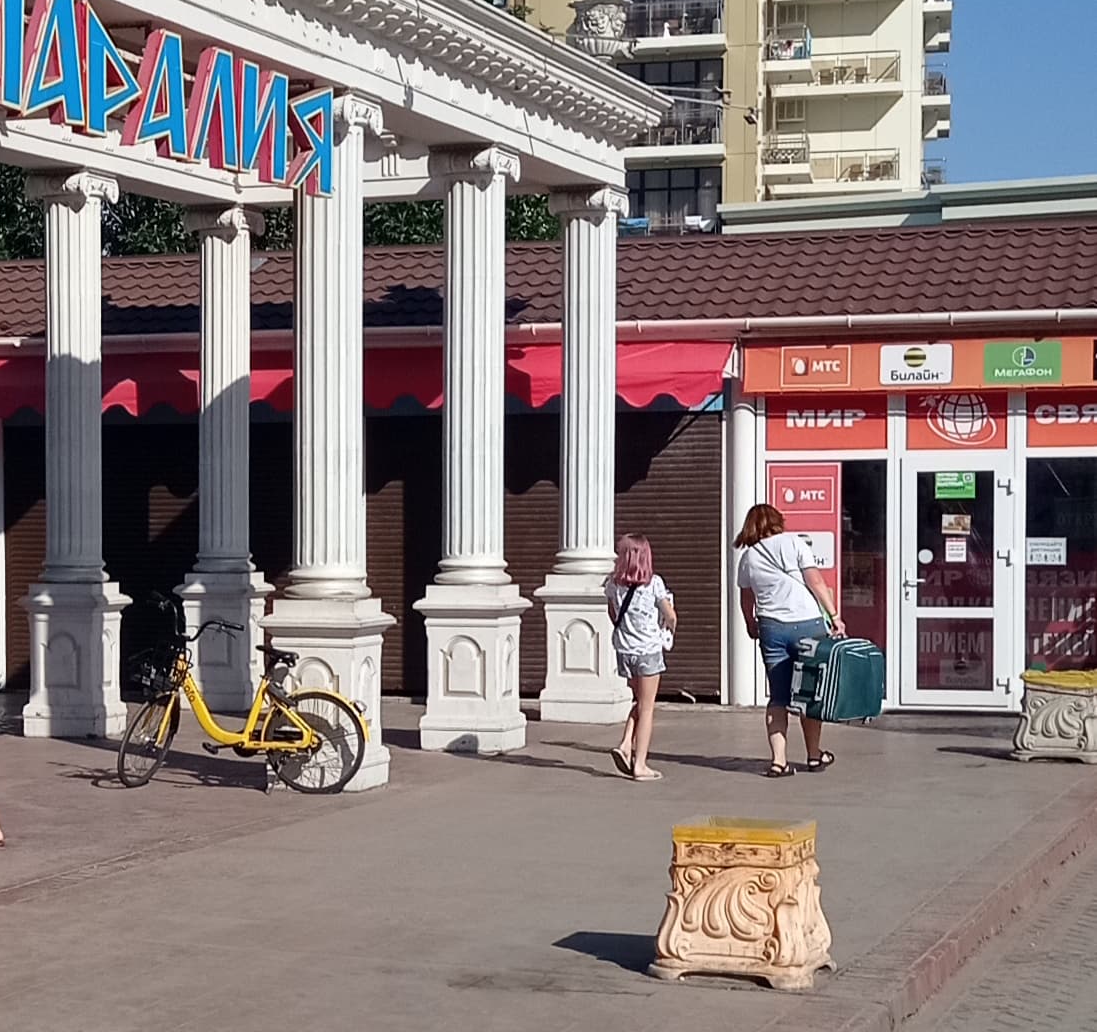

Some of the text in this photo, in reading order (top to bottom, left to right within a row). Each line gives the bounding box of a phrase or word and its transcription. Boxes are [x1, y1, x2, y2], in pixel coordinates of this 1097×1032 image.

[812, 360, 841, 372] МТС
[890, 369, 939, 381] Билайн
[786, 409, 866, 428] МИР
[800, 490, 825, 501] МТС
